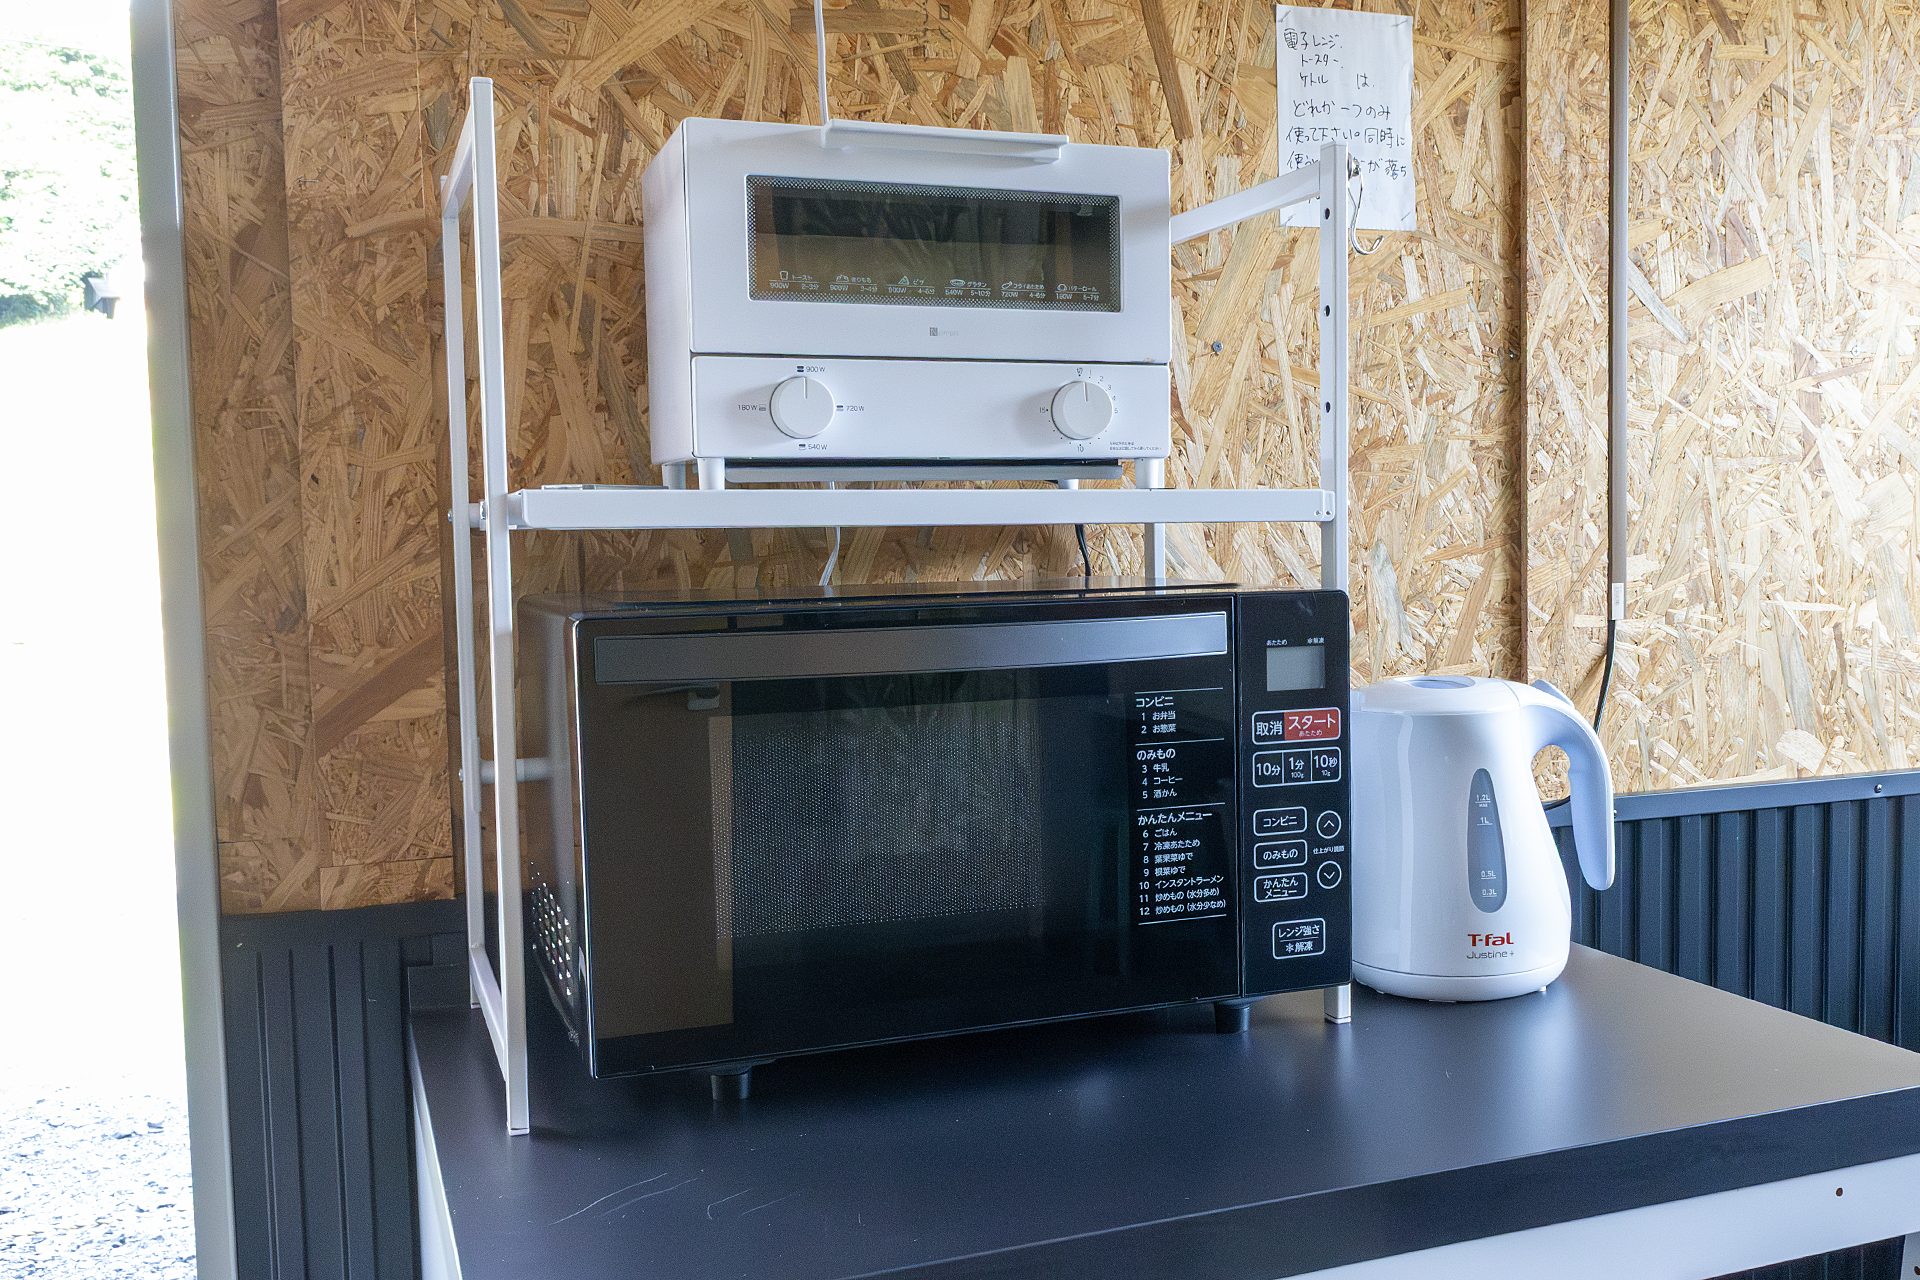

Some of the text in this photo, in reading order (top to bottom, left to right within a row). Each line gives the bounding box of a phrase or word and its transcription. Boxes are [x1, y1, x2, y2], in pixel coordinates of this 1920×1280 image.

[1141, 710, 1176, 721] 1 お弁当
[1288, 713, 1336, 730] スタート
[1141, 725, 1147, 734] 2
[1256, 720, 1283, 736] 取消
[1136, 748, 1176, 761] のみもの
[1288, 757, 1305, 771] 1分
[1313, 754, 1338, 769] 10秒
[1141, 762, 1170, 774] 3 牛乳
[1256, 762, 1281, 776] 10分
[1142, 776, 1183, 786] 4 コーヒー
[1142, 788, 1178, 799] 5 酒かん
[1138, 811, 1213, 826] かんたんメニュー
[1263, 815, 1298, 828] コンビニ
[1480, 816, 1490, 824] 1L
[1142, 828, 1178, 838] 6 ごはん
[1142, 839, 1201, 851] 7 冷凍あたため
[1143, 855, 1149, 864] 8
[1263, 849, 1299, 861] のみもの
[1143, 865, 1186, 877] 9 根菜ゆで
[1480, 870, 1496, 878] 0.5L
[1139, 875, 1224, 890] 10 インスタントラーメン
[1263, 877, 1299, 889] かんたん
[1139, 894, 1149, 903] 11
[1155, 891, 1185, 902] 炒めもの
[1265, 888, 1298, 899] メニュー
[1139, 907, 1150, 916] 12
[1155, 904, 1185, 915] 炒めもの
[1278, 924, 1320, 938] レンジ強さ
[1467, 932, 1514, 947] T-fal
